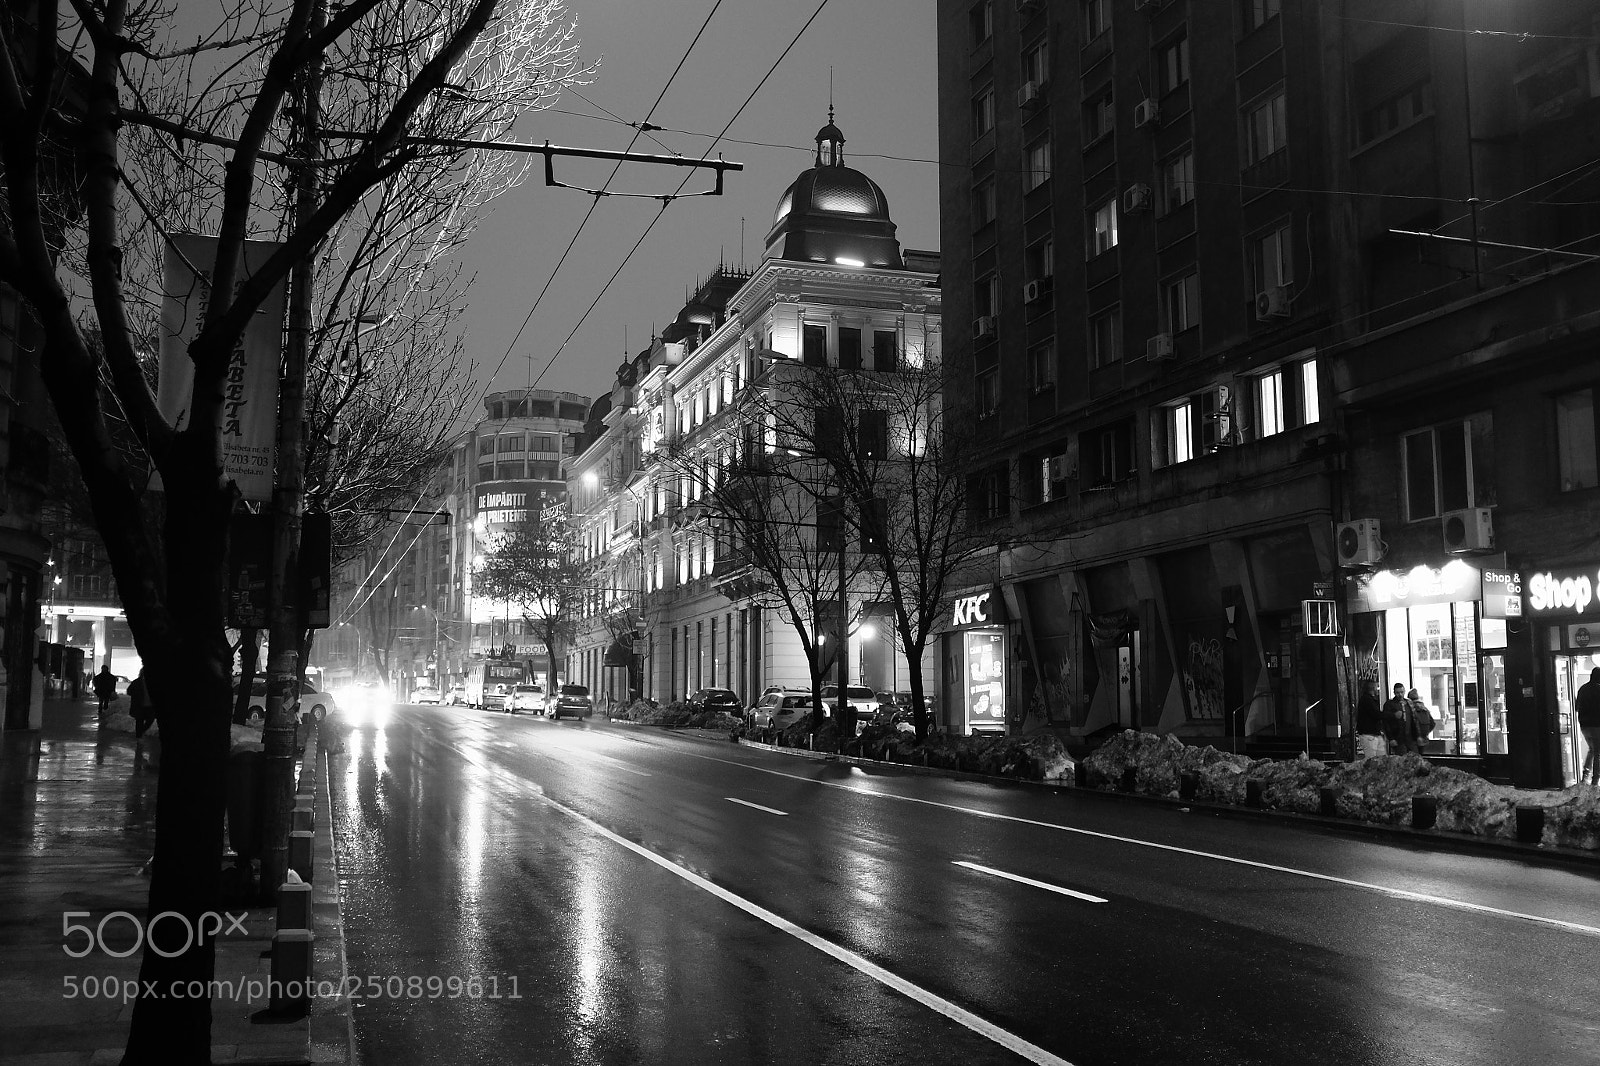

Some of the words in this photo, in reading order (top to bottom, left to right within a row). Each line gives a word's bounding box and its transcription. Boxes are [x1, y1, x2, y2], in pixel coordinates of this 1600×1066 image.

[231, 453, 249, 465] 703
[251, 455, 269, 467] 703
[478, 495, 486, 508] DE
[1485, 571, 1511, 585] Shop
[1513, 573, 1521, 583] &
[1506, 582, 1521, 593] Go
[1529, 571, 1592, 614] Shop
[953, 592, 990, 626] KFC
